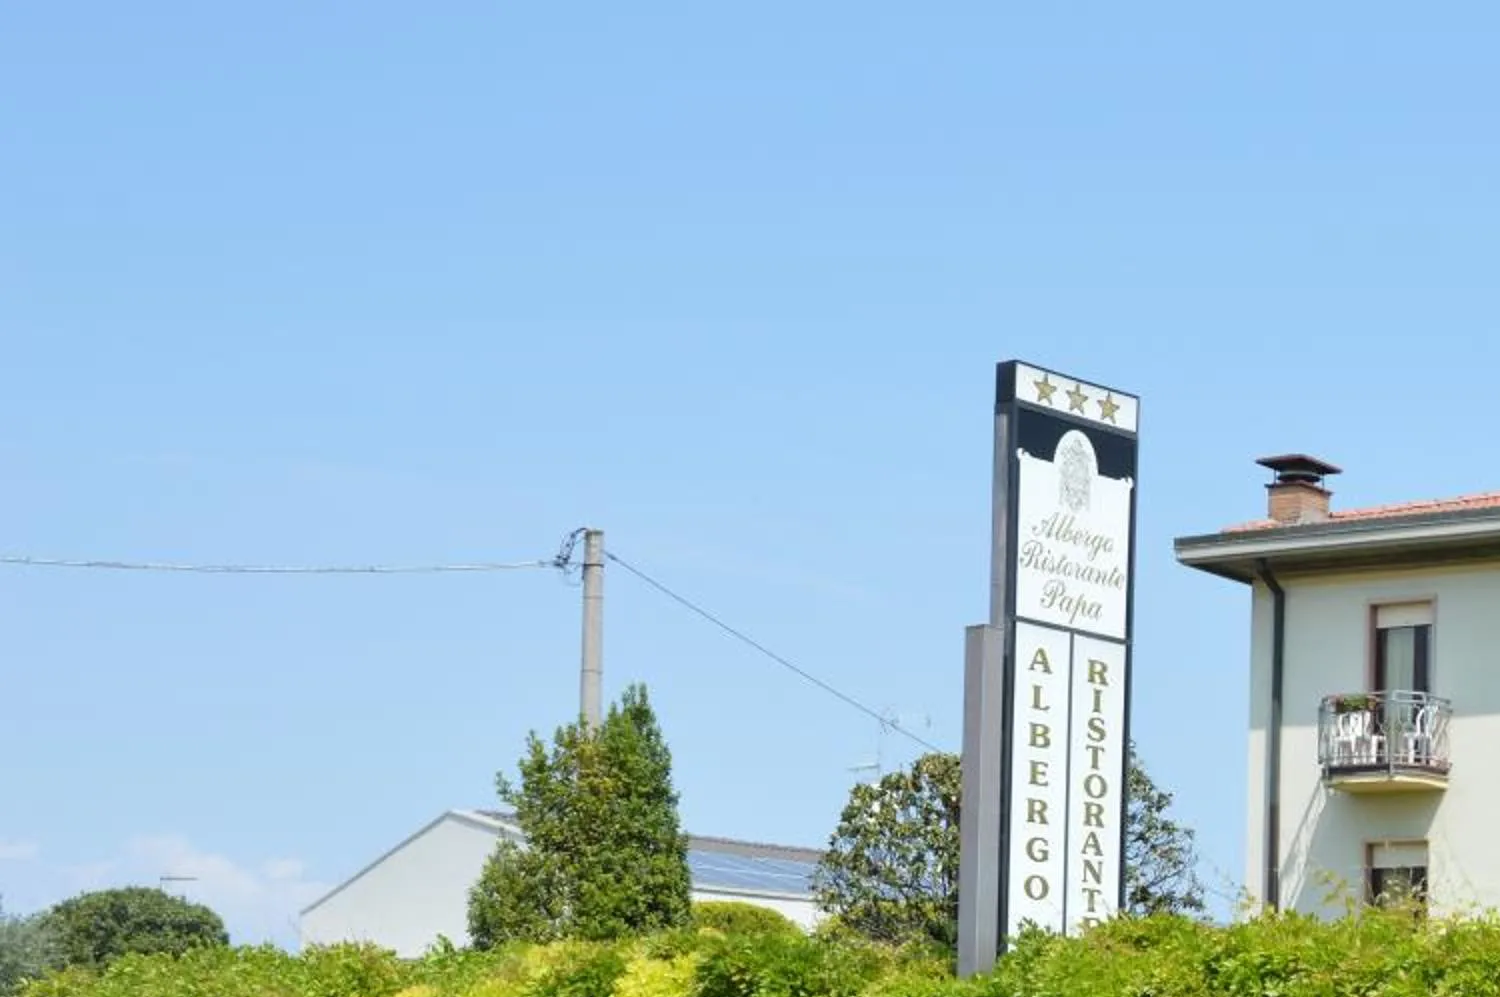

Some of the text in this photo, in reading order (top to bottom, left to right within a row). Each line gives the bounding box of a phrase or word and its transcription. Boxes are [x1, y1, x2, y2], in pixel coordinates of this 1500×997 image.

[1031, 512, 1114, 562] Albergo
[1019, 540, 1125, 590] Ristorante
[1024, 648, 1052, 900] ALBERGO
